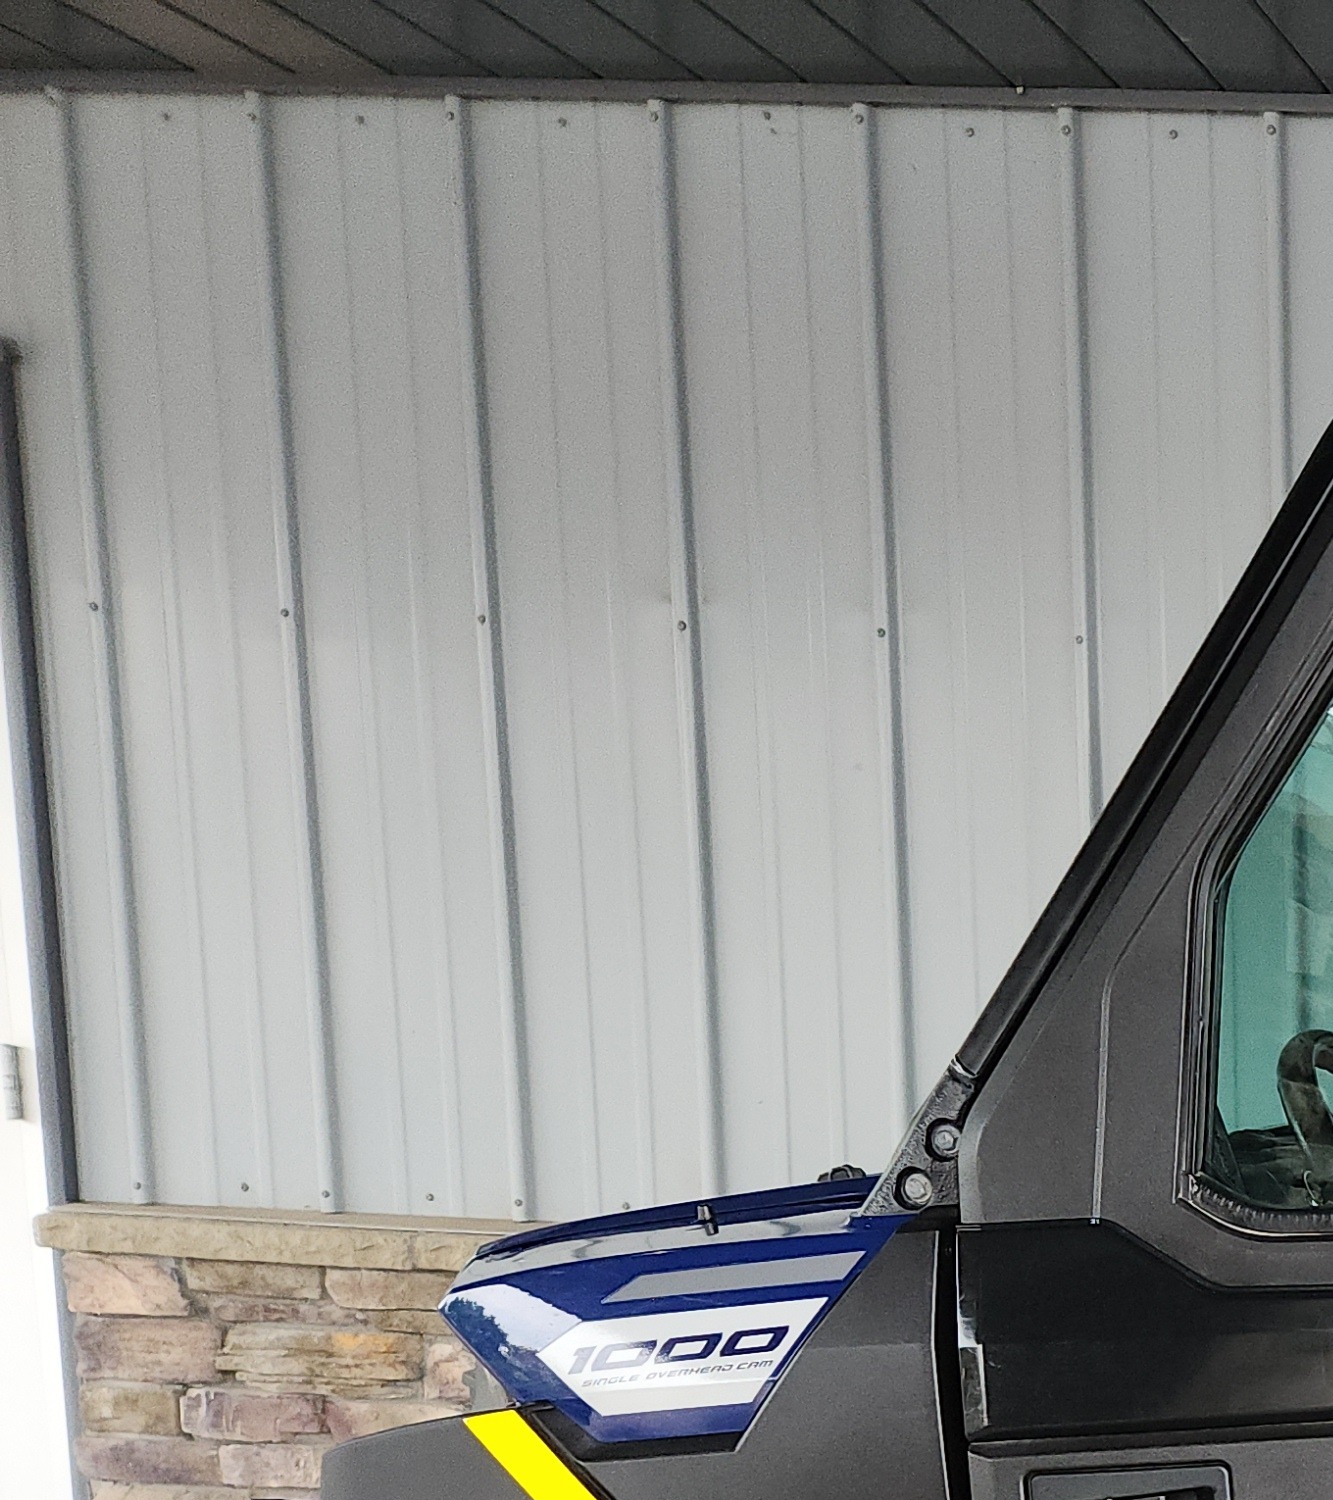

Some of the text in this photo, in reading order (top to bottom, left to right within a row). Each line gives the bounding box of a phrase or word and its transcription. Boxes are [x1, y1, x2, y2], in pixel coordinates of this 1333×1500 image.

[568, 1325, 790, 1375] 1000
[581, 1359, 774, 1387] SINGLE OVERHEAD CAM
